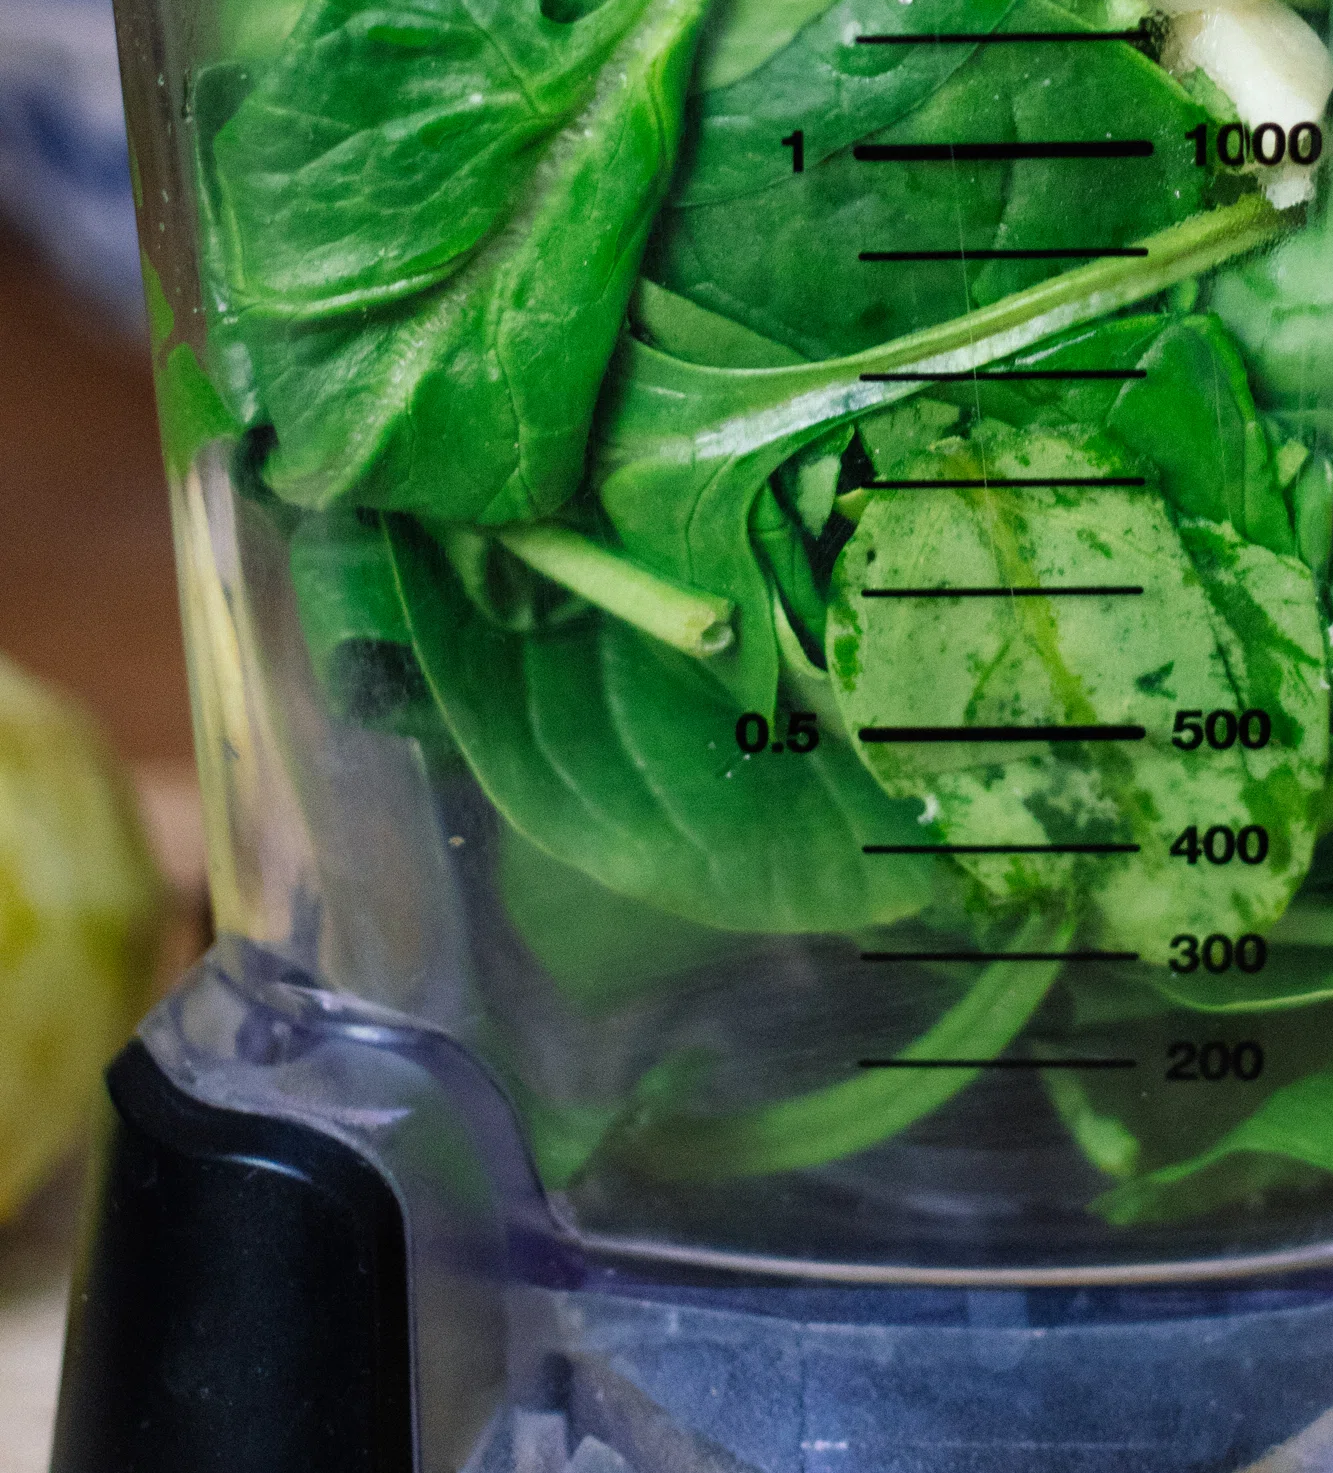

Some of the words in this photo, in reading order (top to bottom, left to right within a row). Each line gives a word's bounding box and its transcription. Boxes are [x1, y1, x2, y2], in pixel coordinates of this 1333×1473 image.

[781, 132, 805, 172] 1
[1184, 123, 1323, 166] 1000
[734, 713, 820, 755] 0.5
[1172, 710, 1272, 750] 500
[1170, 825, 1270, 866] 400
[1167, 935, 1268, 976] 300
[1165, 1040, 1264, 1081] 200
